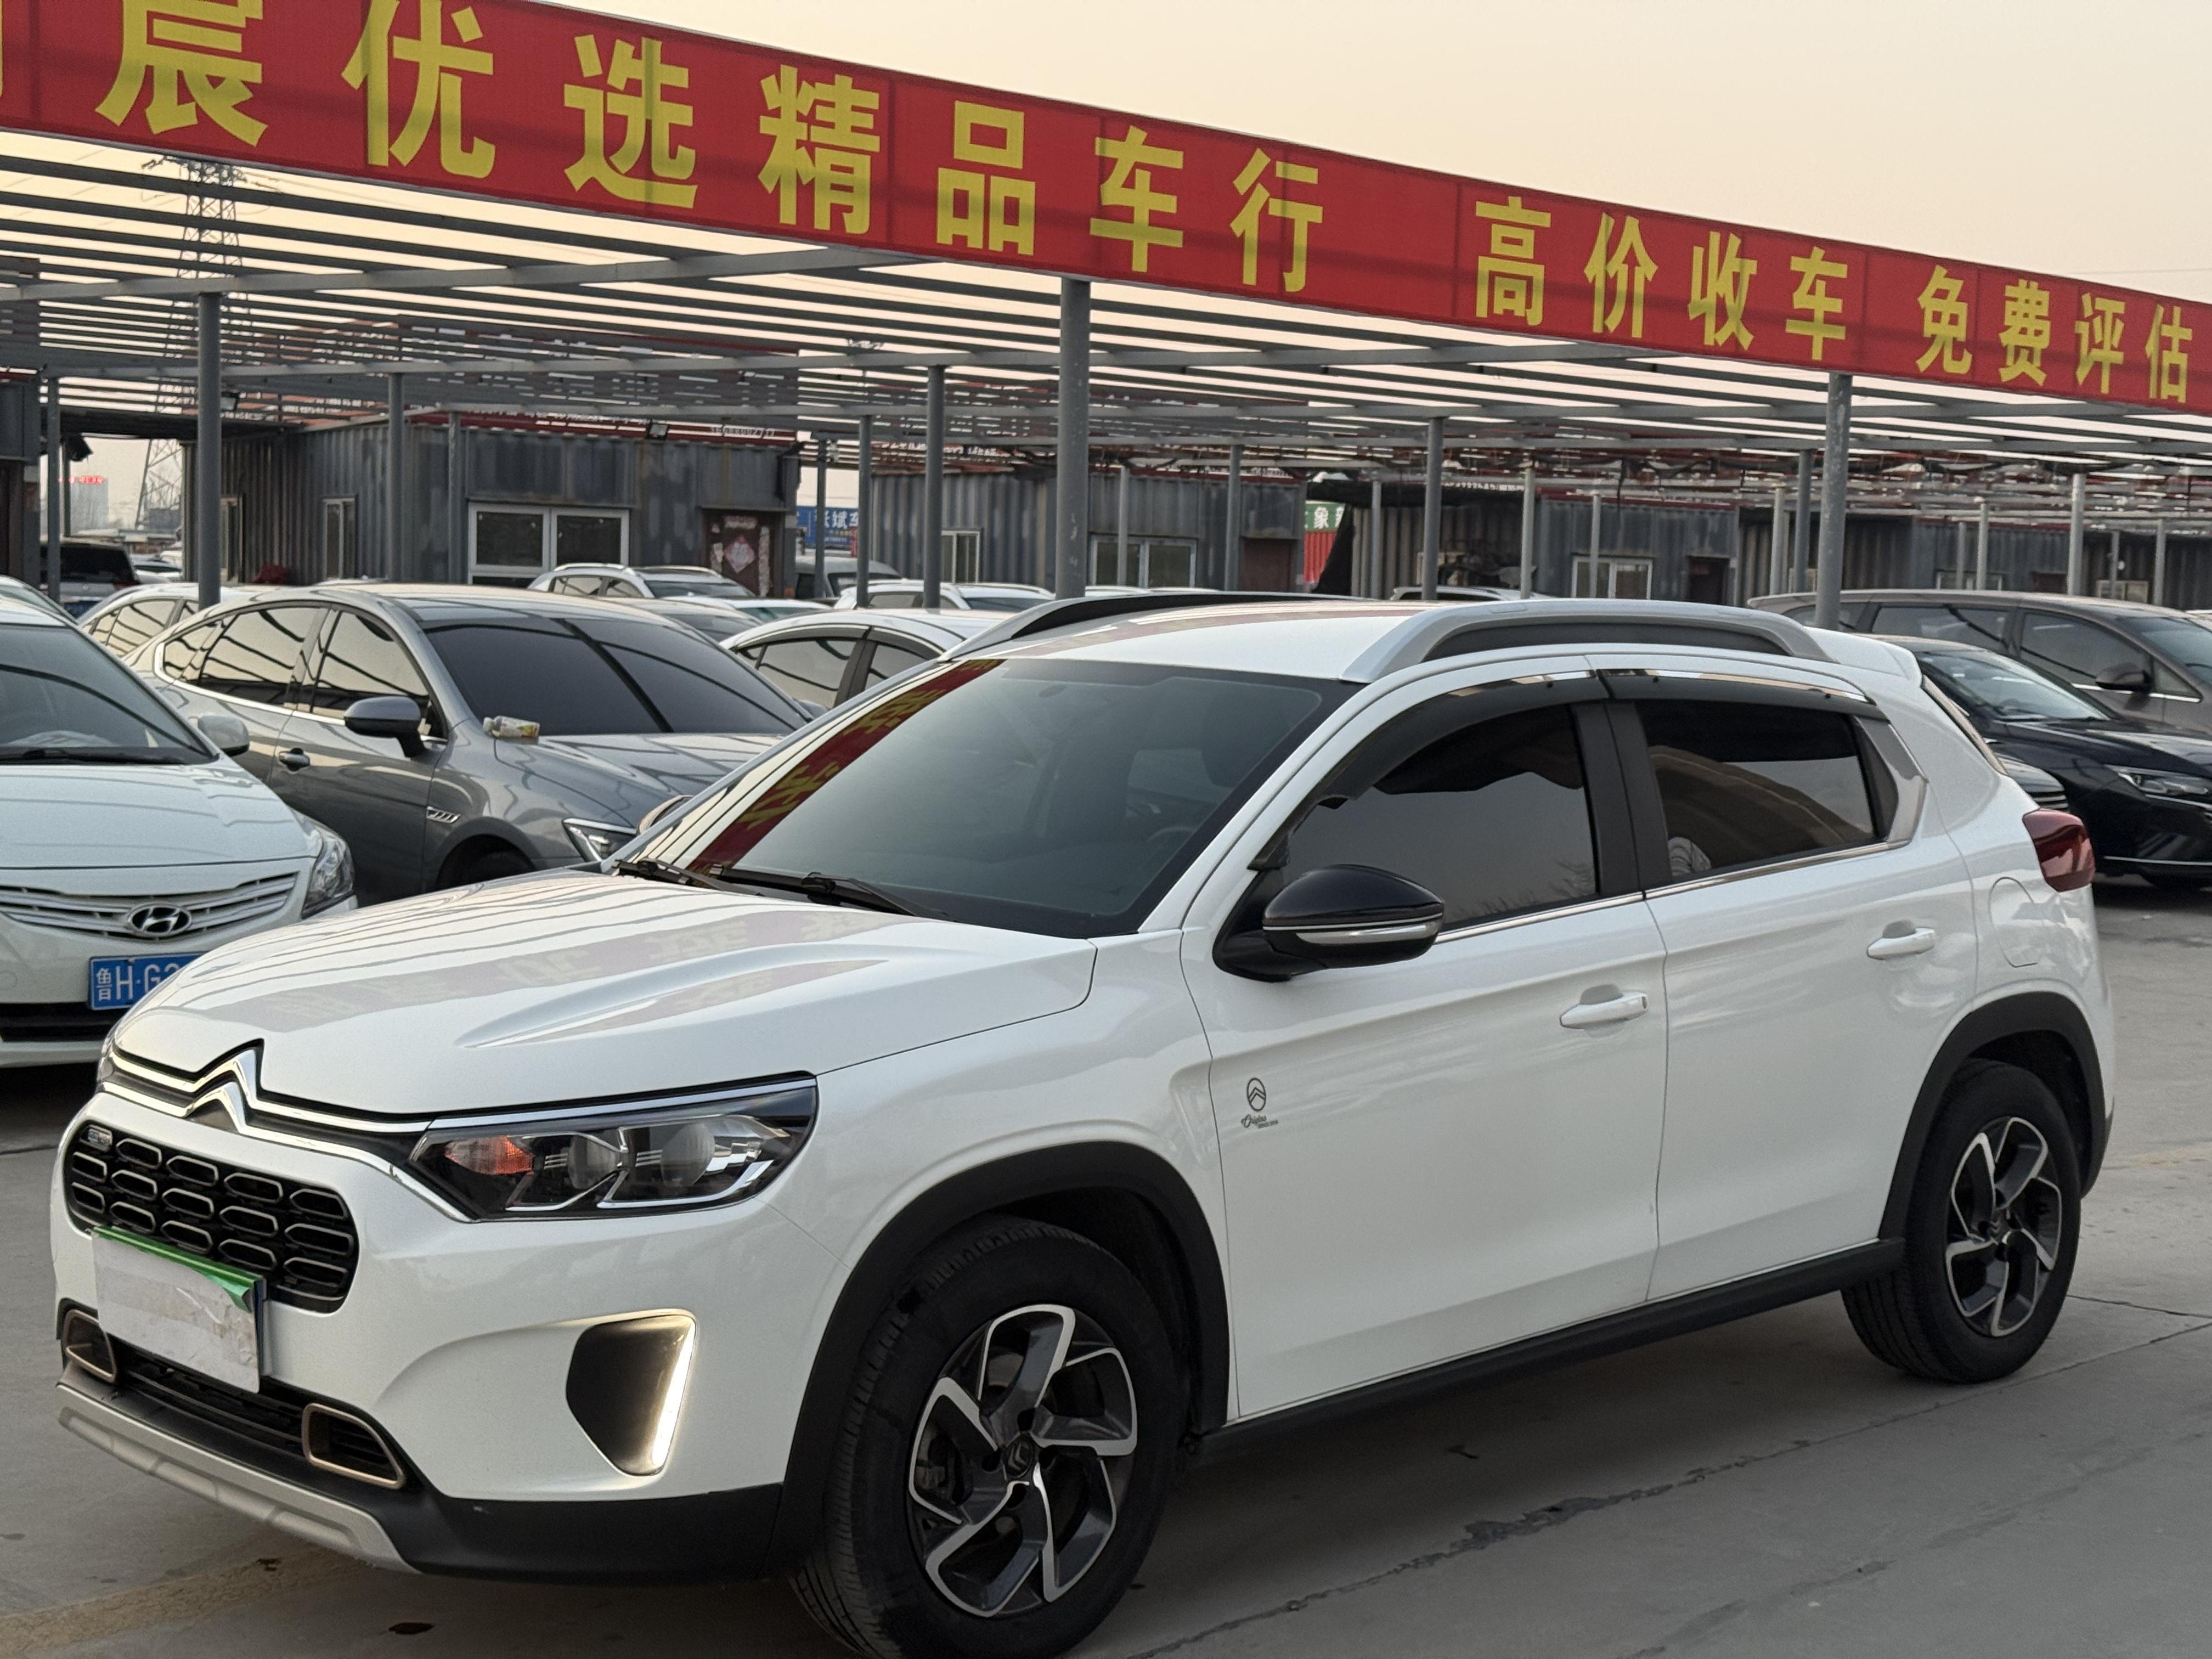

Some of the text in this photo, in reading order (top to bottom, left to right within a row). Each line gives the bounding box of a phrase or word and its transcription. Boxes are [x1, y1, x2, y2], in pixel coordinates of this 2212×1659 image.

[0, 0, 2192, 403] 宸优选精品车行 高价收车 免费评估
